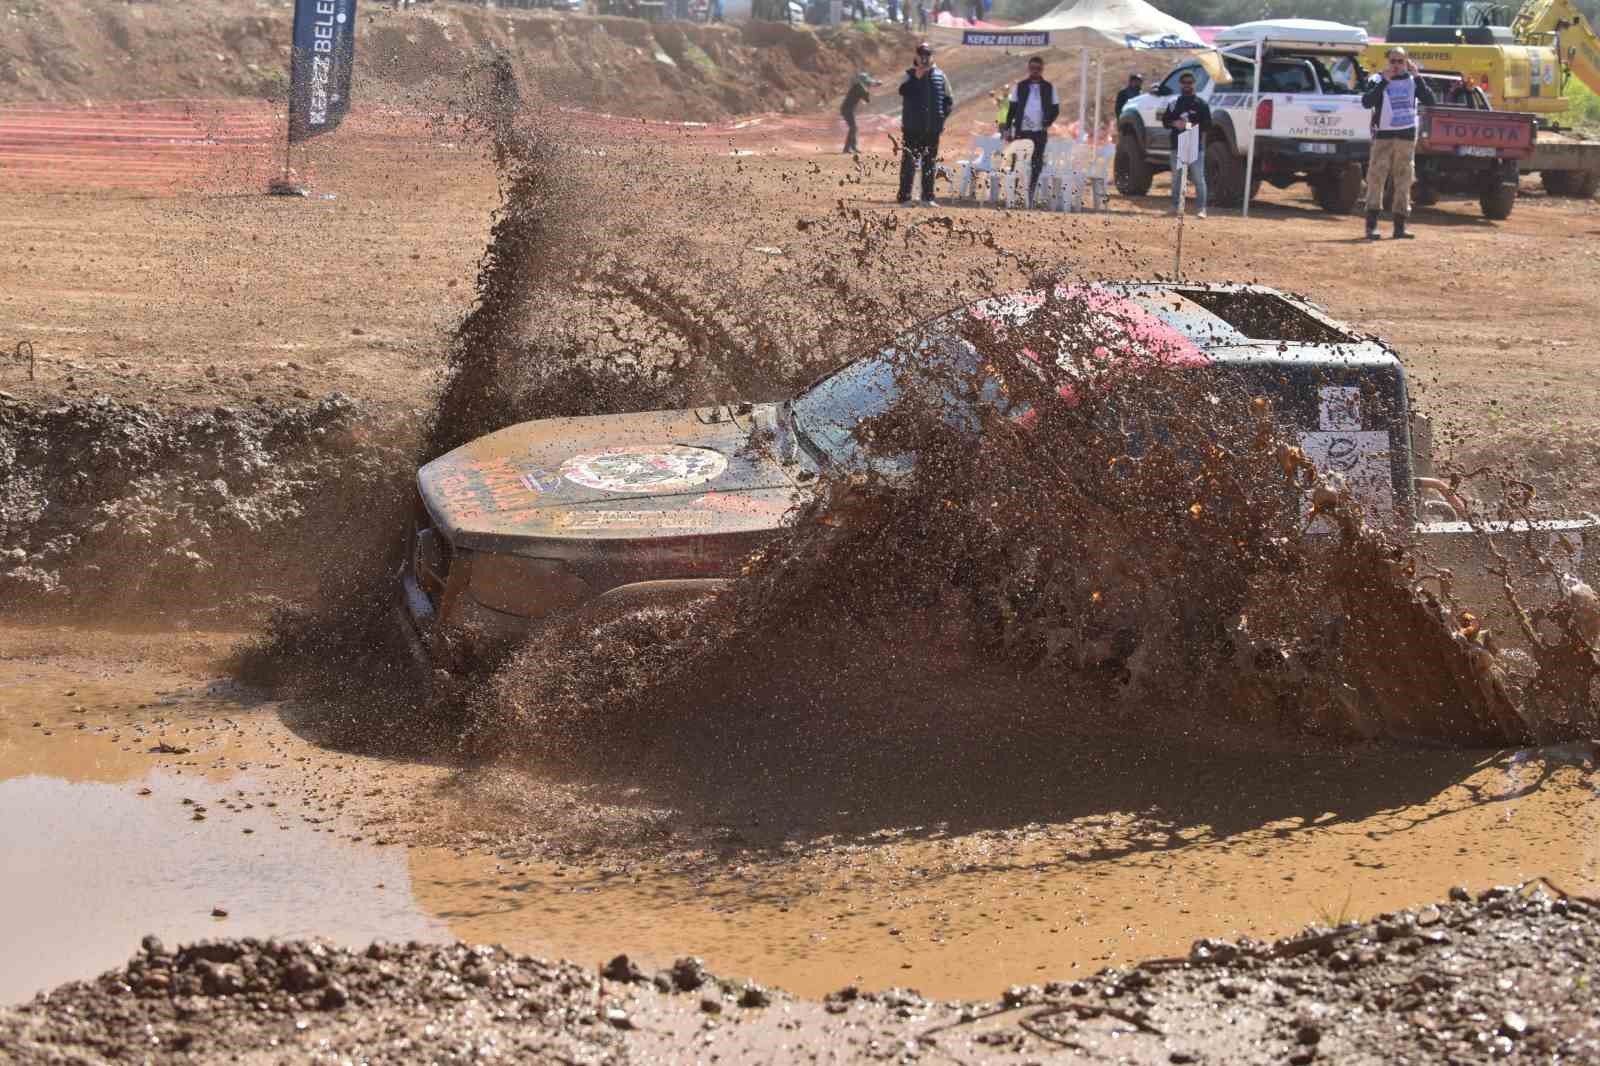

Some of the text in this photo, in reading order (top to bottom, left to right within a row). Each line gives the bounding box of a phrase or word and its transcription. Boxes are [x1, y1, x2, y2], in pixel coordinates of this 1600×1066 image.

[314, 0, 336, 52] BELE
[967, 35, 995, 45] KEPEZ
[1312, 127, 1355, 137] MOTORS
[1443, 125, 1521, 142] TOYOTA
